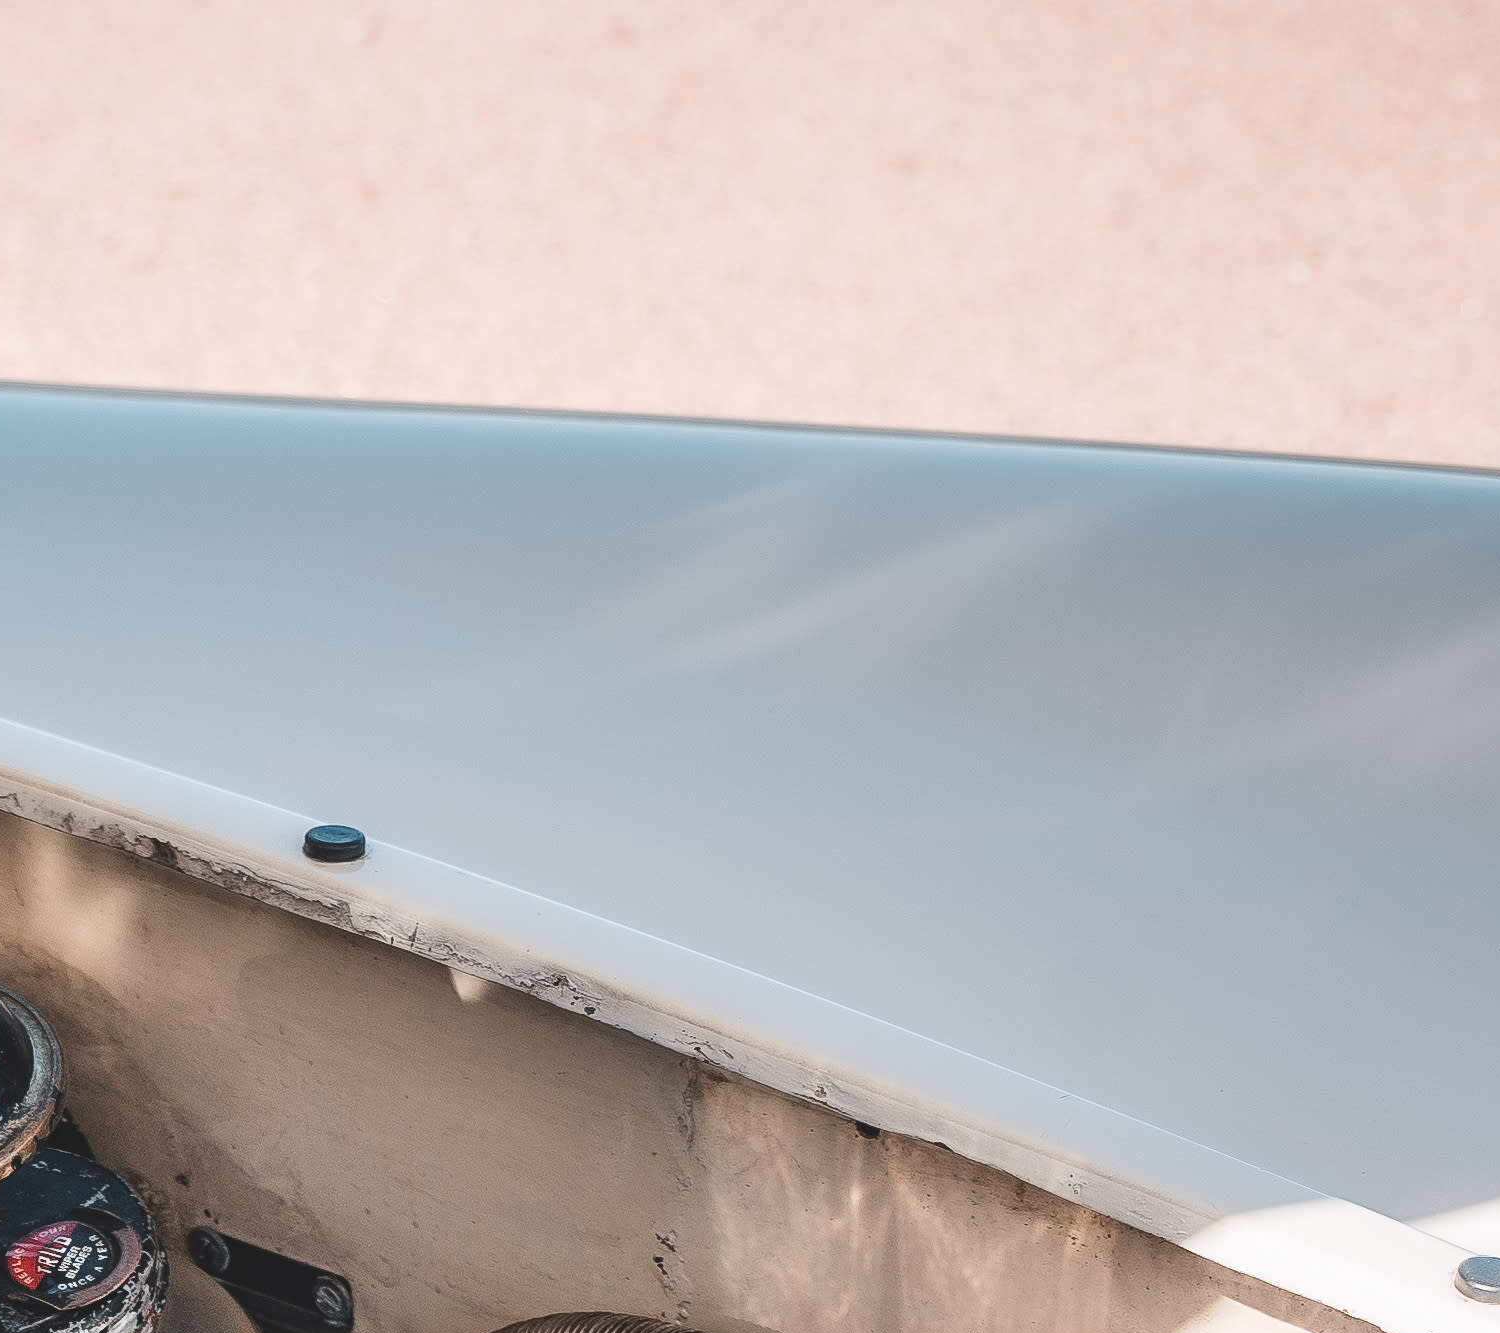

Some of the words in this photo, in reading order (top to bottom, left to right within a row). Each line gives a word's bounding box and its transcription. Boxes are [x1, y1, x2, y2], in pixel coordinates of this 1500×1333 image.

[57, 1274, 96, 1291] ONCE
[88, 1234, 108, 1262] YEAR
[58, 1246, 82, 1273] WIPER
[65, 1245, 93, 1280] BLADES
